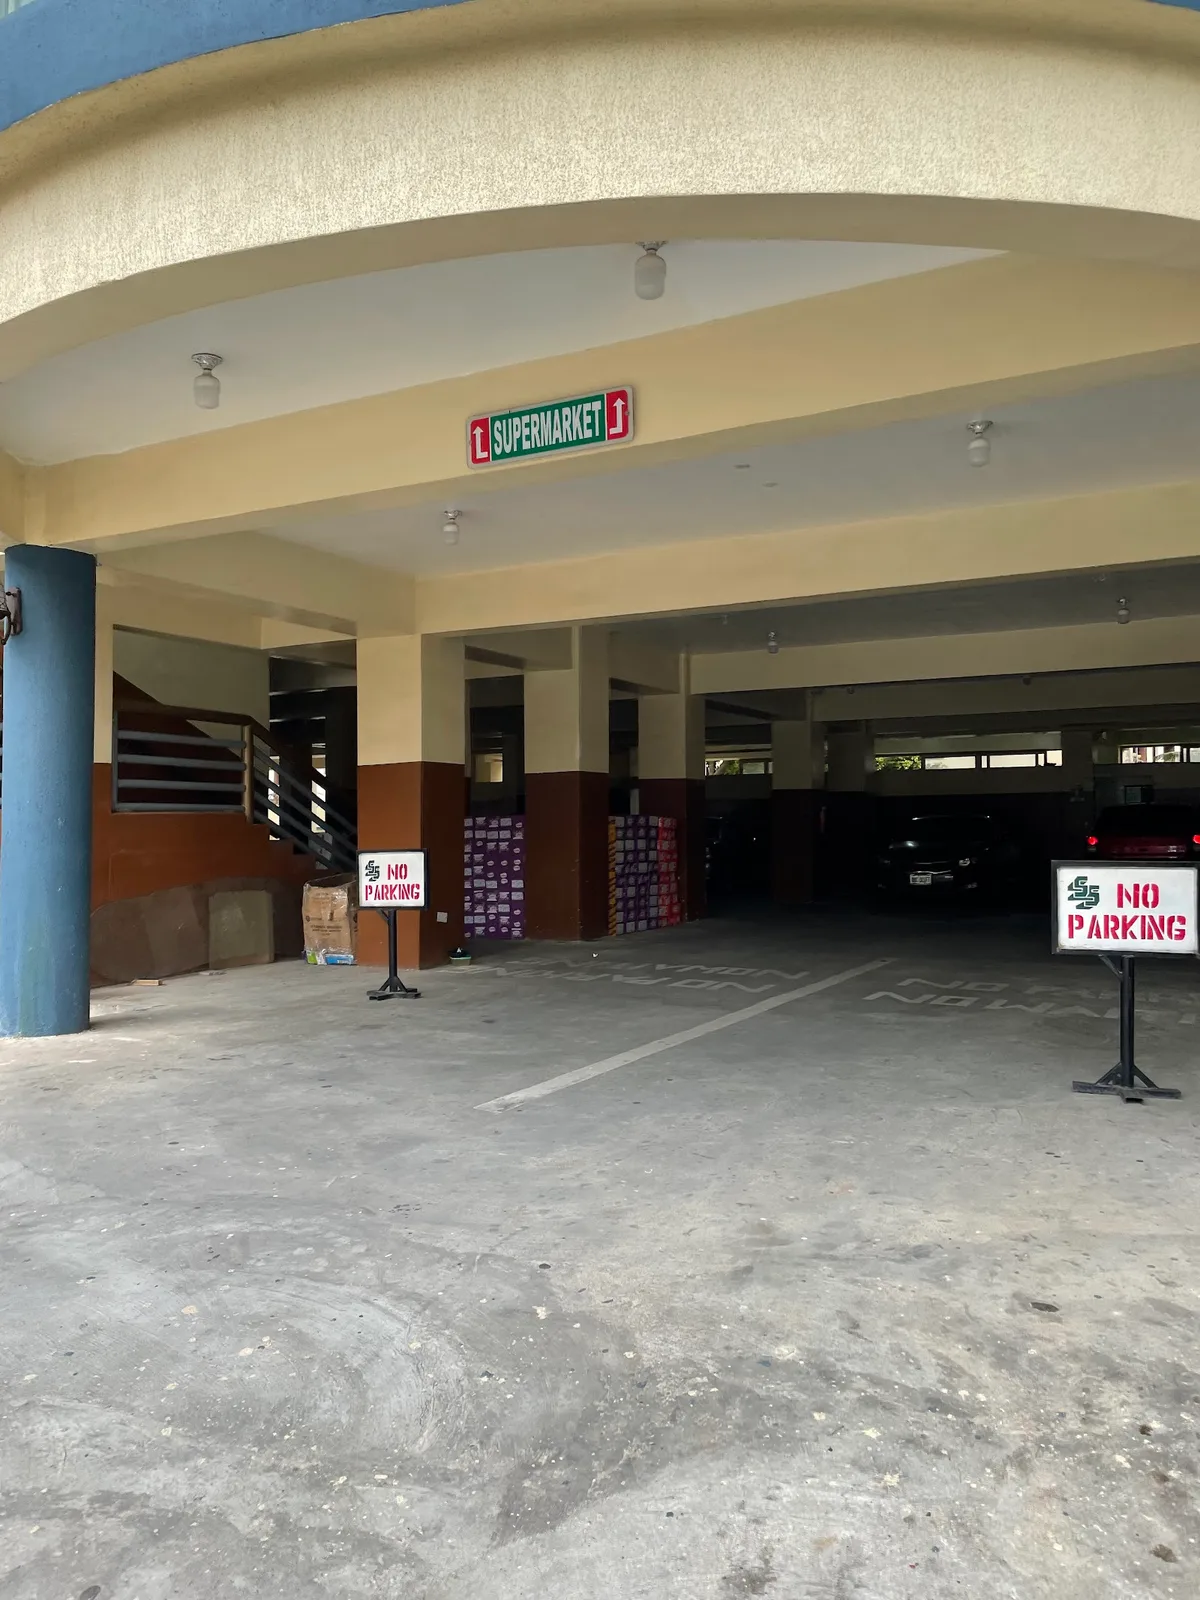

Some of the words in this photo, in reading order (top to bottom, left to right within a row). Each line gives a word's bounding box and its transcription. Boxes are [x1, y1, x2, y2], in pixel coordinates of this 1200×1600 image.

[494, 401, 602, 455] SUPERMARKET
[387, 864, 408, 880] NO
[365, 884, 421, 901] PARKING
[1117, 883, 1159, 909] NO
[1068, 914, 1187, 941] PARKING
[897, 978, 1010, 992] NO
[862, 991, 980, 1007] NO
